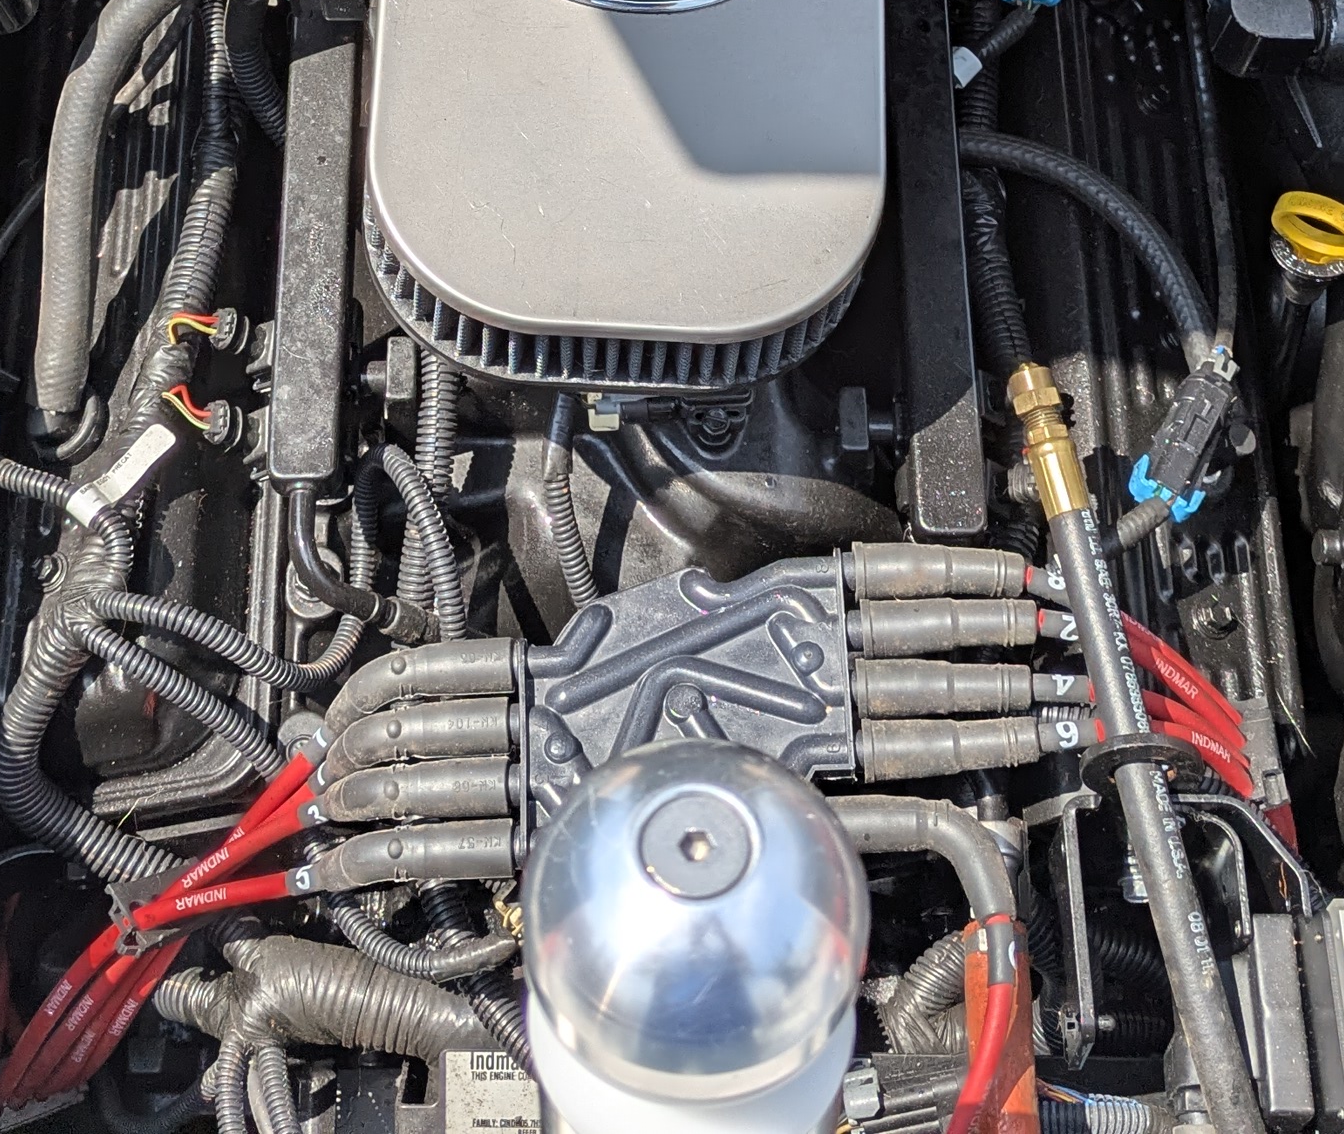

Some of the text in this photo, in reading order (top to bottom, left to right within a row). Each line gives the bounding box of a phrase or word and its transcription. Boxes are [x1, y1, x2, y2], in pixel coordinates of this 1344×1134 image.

[112, 452, 132, 474] PRECAT
[1060, 614, 1079, 641] 2
[1051, 673, 1075, 696] 4
[1056, 721, 1079, 748] 6
[1149, 770, 1173, 812] MADE
[1162, 817, 1177, 832] IN
[308, 804, 329, 824] 3
[181, 847, 230, 889] INDMAR
[295, 864, 313, 889] 5
[175, 887, 227, 911] INDMAR
[1187, 911, 1204, 933] 08
[43, 979, 72, 1016] INDMAR
[66, 994, 94, 1031] INDMAR
[108, 998, 139, 1036] INDMAR
[470, 1052, 524, 1070] Indma
[471, 1071, 488, 1081] THIS
[490, 1071, 515, 1080] ENGINE
[472, 1118, 498, 1128] FAMILY:
